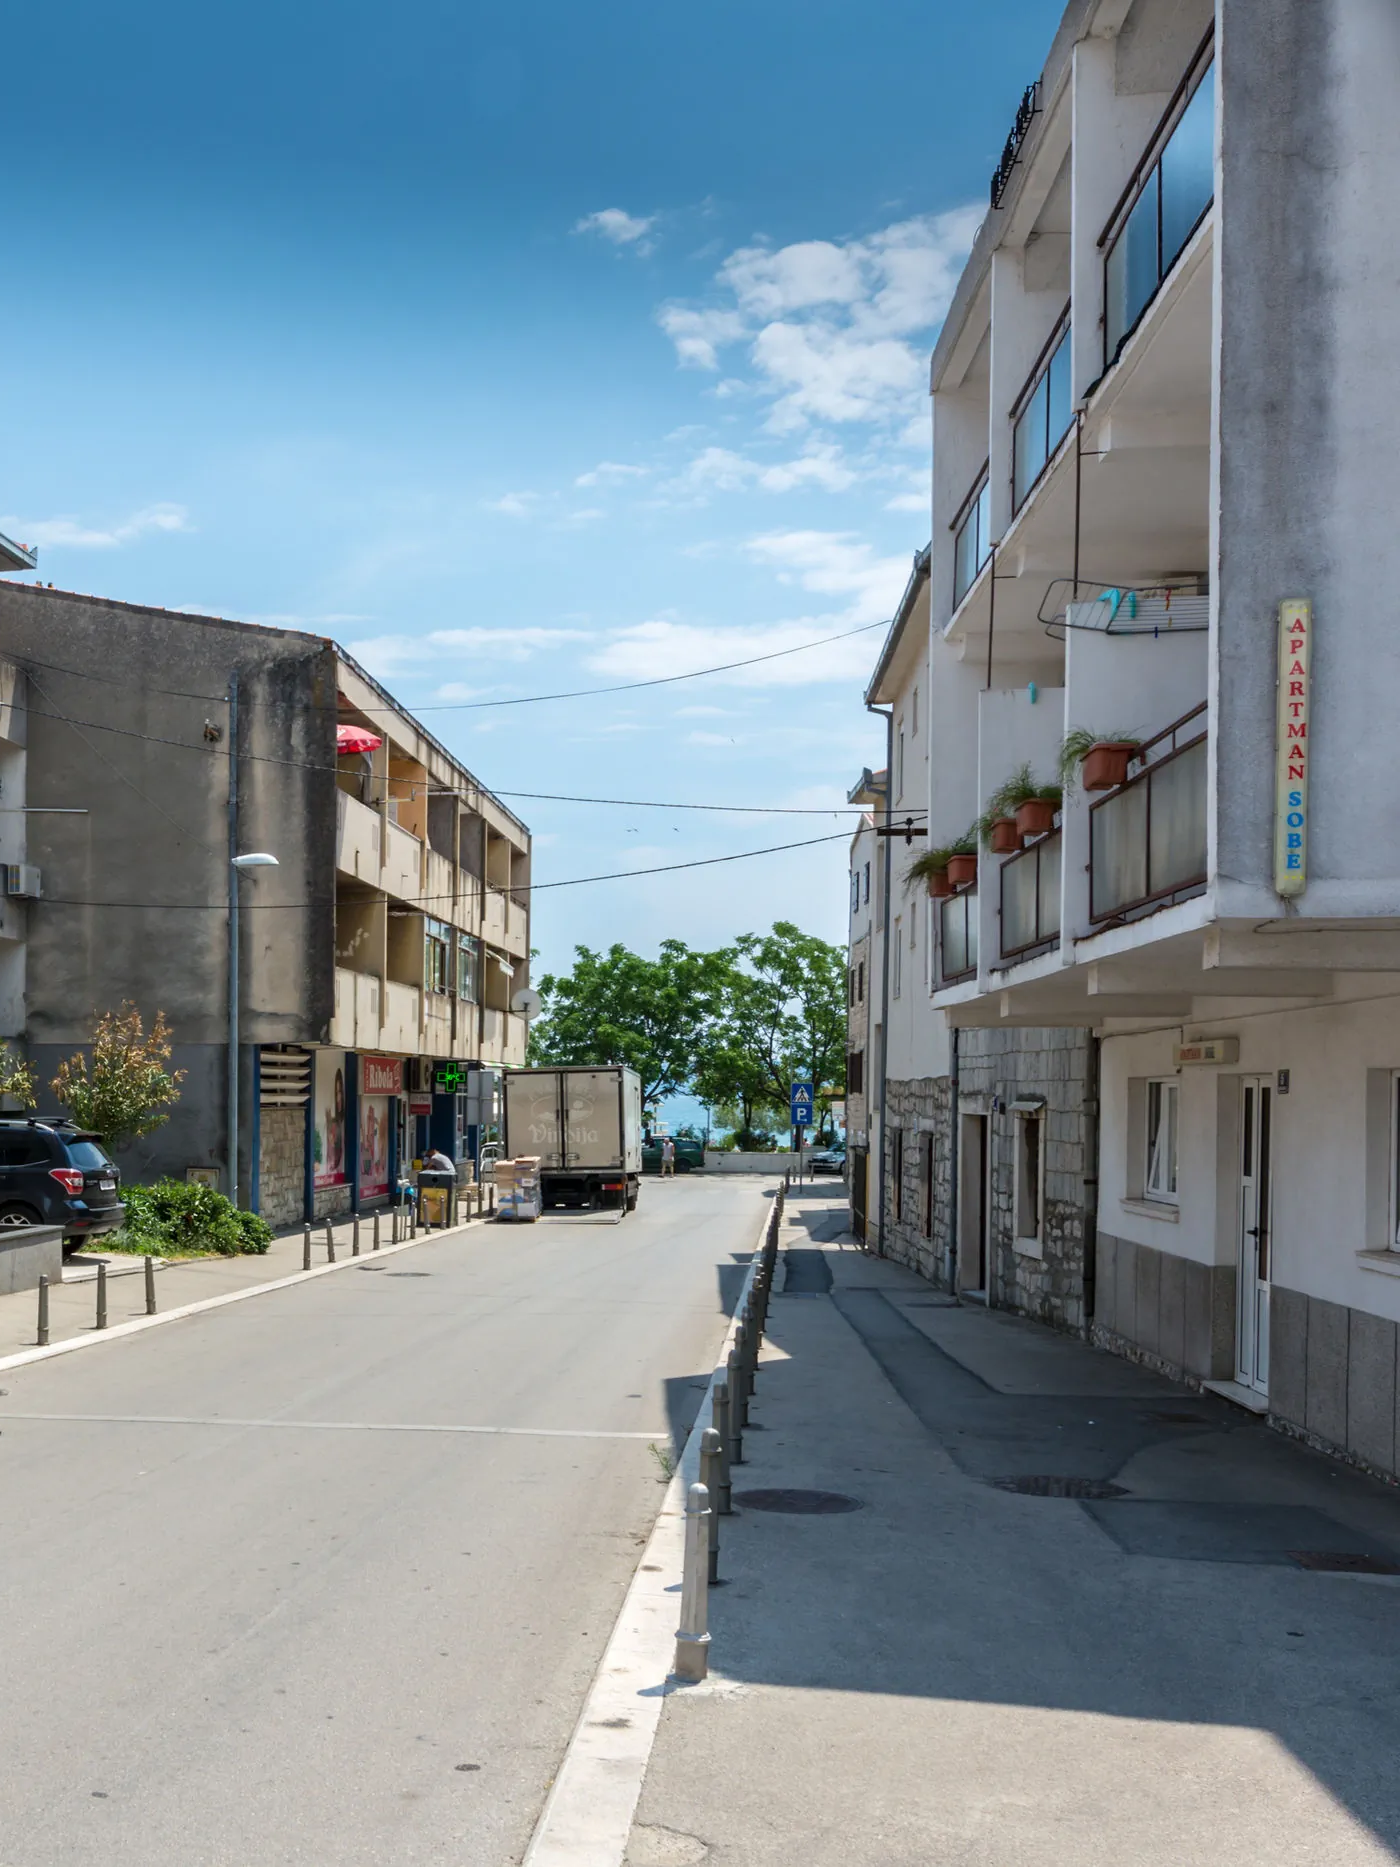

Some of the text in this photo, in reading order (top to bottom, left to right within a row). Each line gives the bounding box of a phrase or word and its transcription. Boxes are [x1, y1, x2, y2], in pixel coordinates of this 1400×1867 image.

[1286, 617, 1306, 869] APARTMAN SOBE
[369, 1063, 394, 1088] Ribola
[796, 1107, 807, 1121] P
